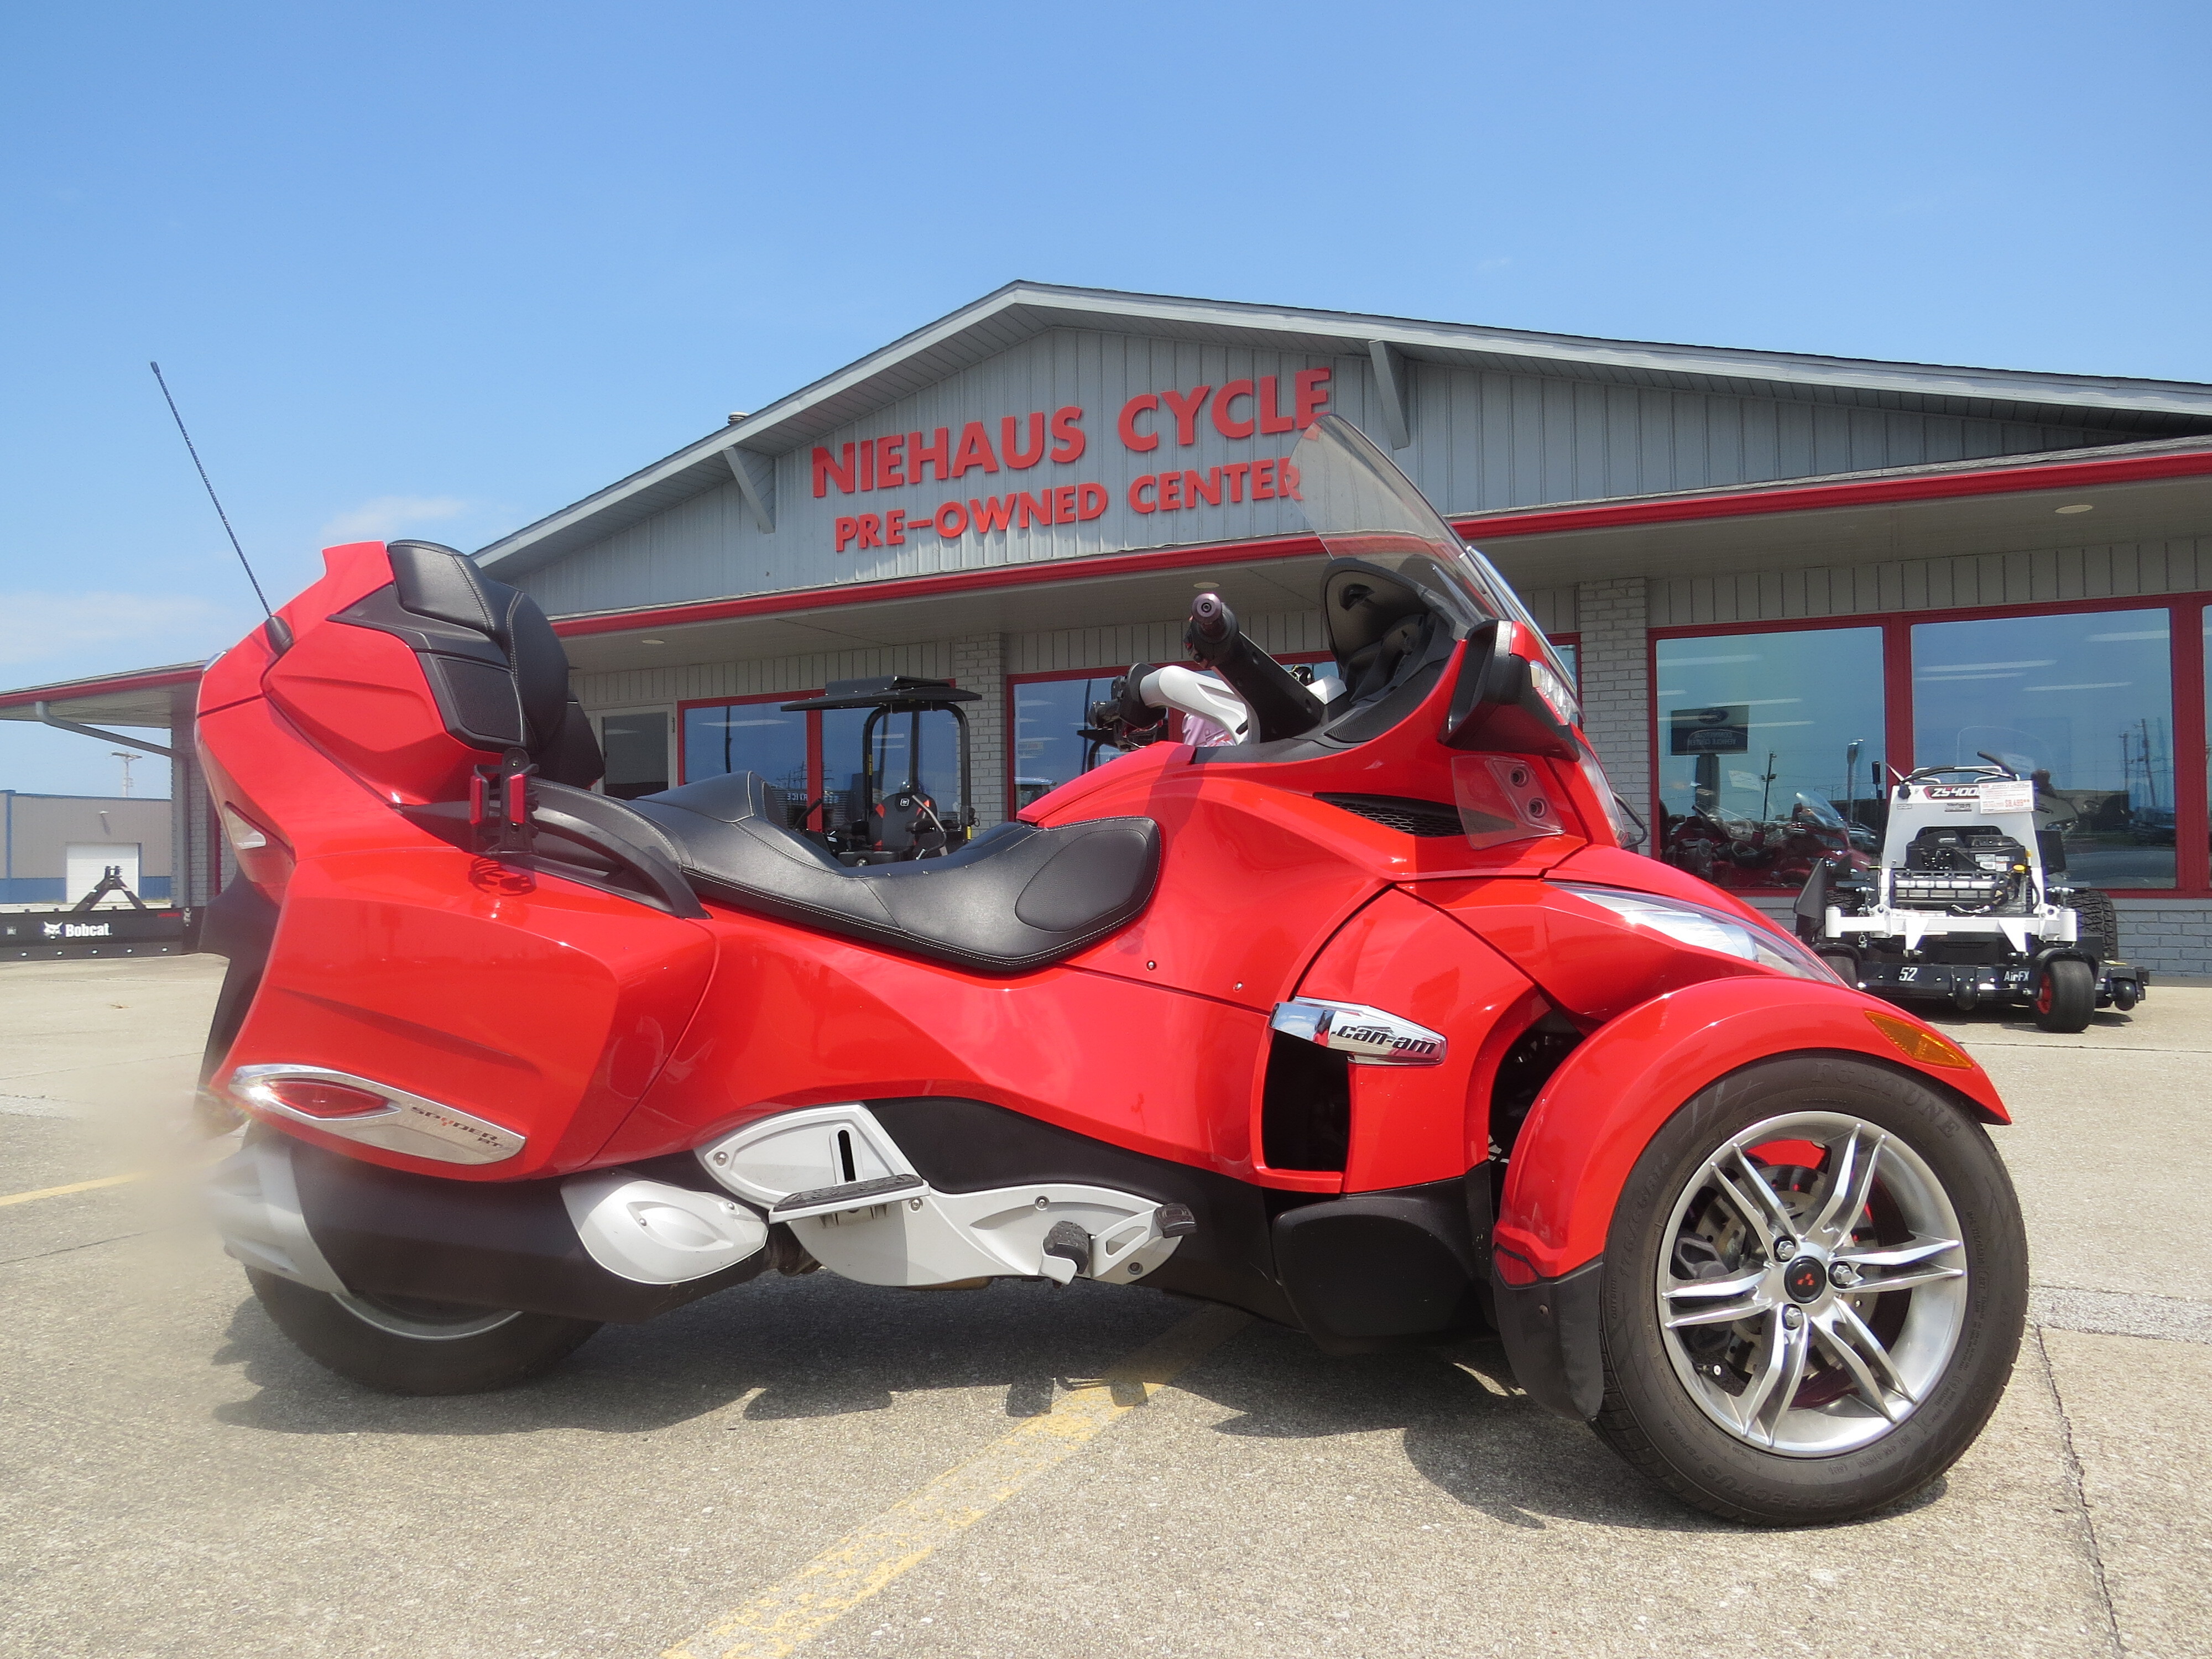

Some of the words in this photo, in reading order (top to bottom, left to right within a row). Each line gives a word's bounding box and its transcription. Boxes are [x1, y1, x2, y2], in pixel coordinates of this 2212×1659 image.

[812, 406, 1086, 498] NIEHAUS
[1118, 367, 1332, 452] CYCLE
[835, 482, 1107, 552] PRE-OWNED
[1129, 456, 1303, 514] CENTER
[1932, 787, 1980, 797] ZS400
[1898, 967, 1918, 982] 52
[2004, 971, 2030, 982] AirFX
[1337, 1024, 1436, 1055] can-am
[411, 1107, 498, 1141] SPYDER
